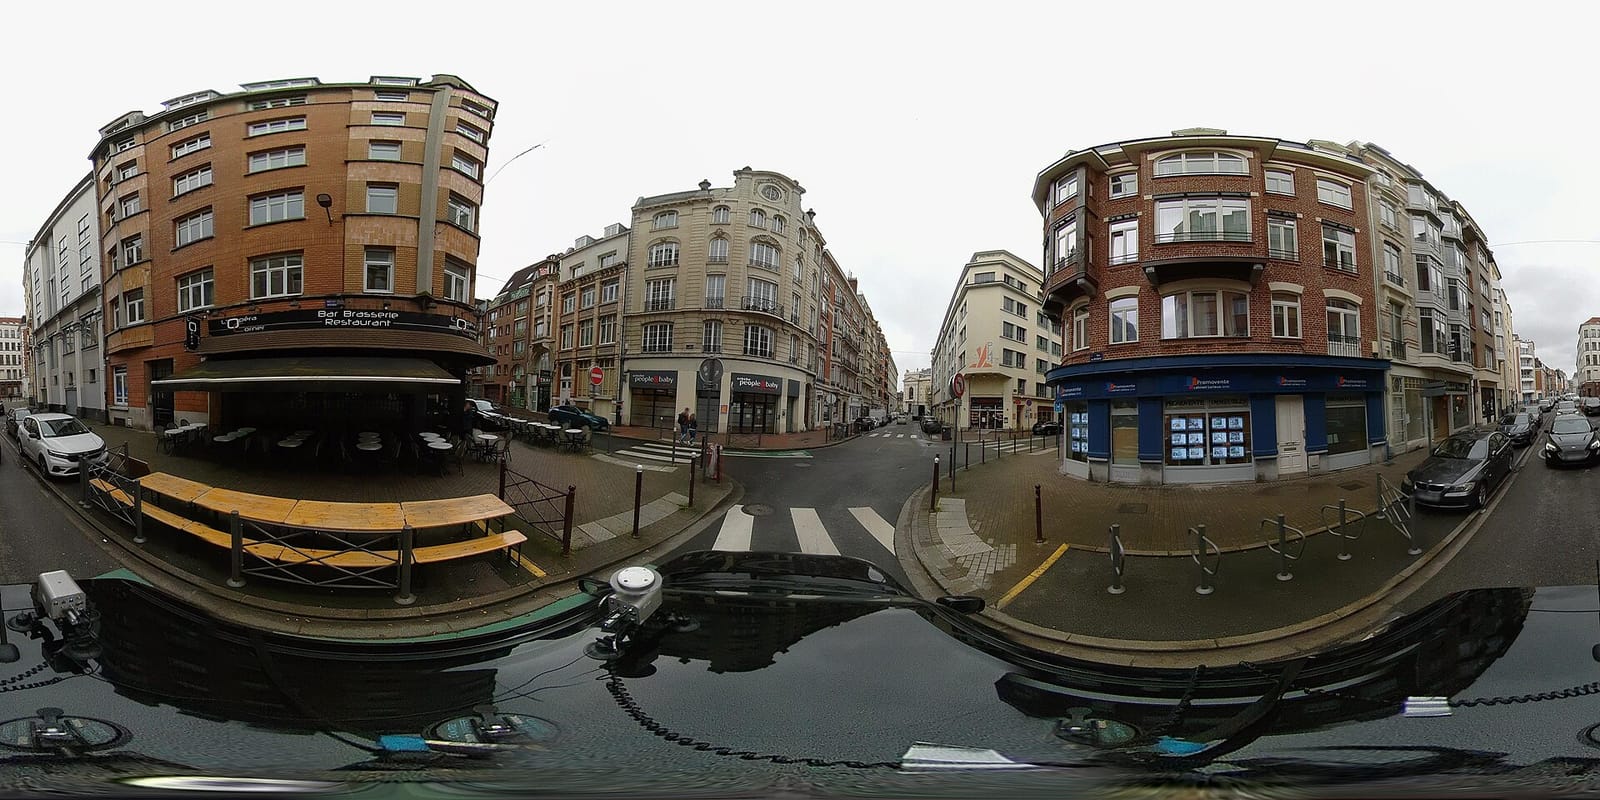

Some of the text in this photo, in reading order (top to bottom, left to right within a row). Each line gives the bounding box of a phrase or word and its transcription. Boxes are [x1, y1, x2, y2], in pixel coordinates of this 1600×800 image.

[317, 310, 399, 319] Bar Brasserie
[324, 318, 391, 327] Restaurant
